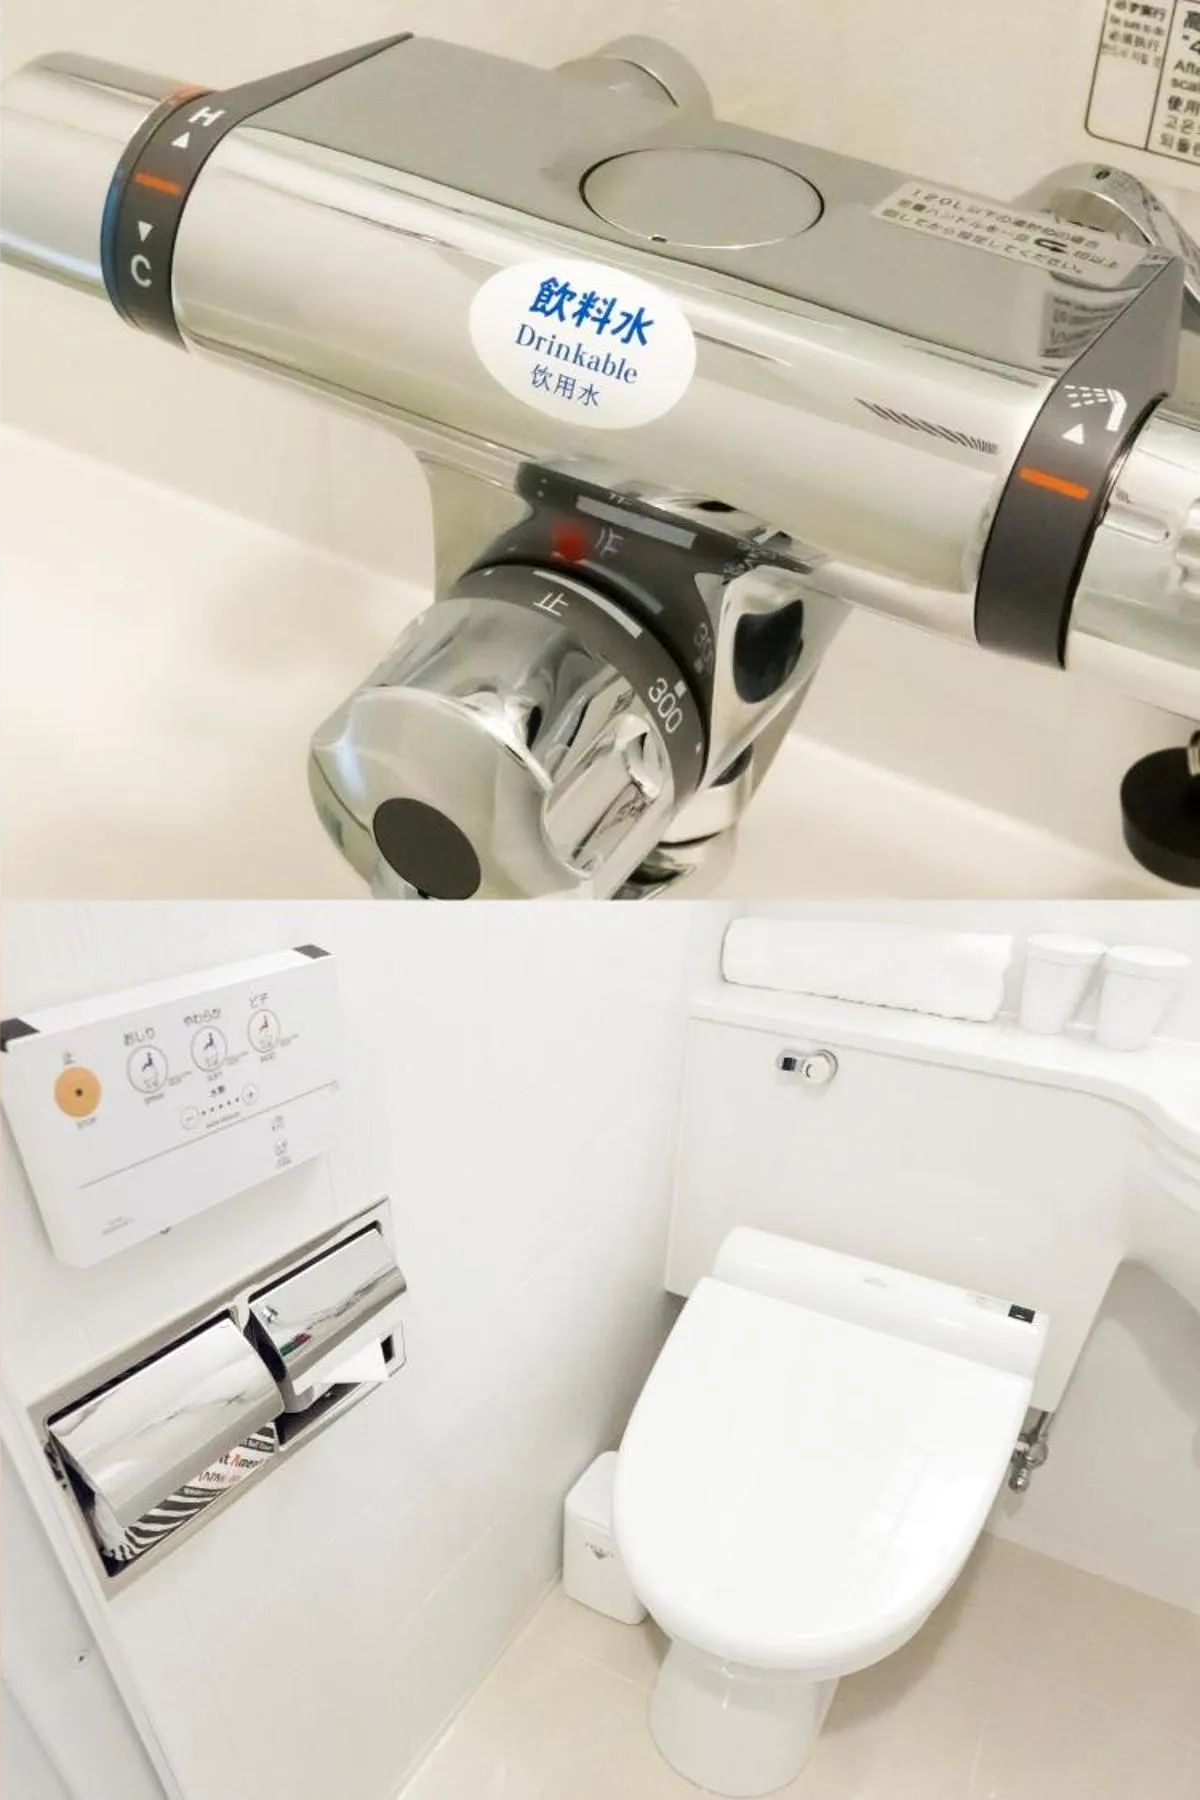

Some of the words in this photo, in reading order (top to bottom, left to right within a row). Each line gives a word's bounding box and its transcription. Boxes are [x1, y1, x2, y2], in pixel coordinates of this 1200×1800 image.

[188, 106, 226, 127] H
[131, 254, 152, 287] C
[529, 277, 654, 346] 飲料水
[515, 323, 638, 385] Drinkable
[530, 363, 601, 407] 饮用水
[533, 592, 569, 617] 止
[648, 677, 683, 733] 300
